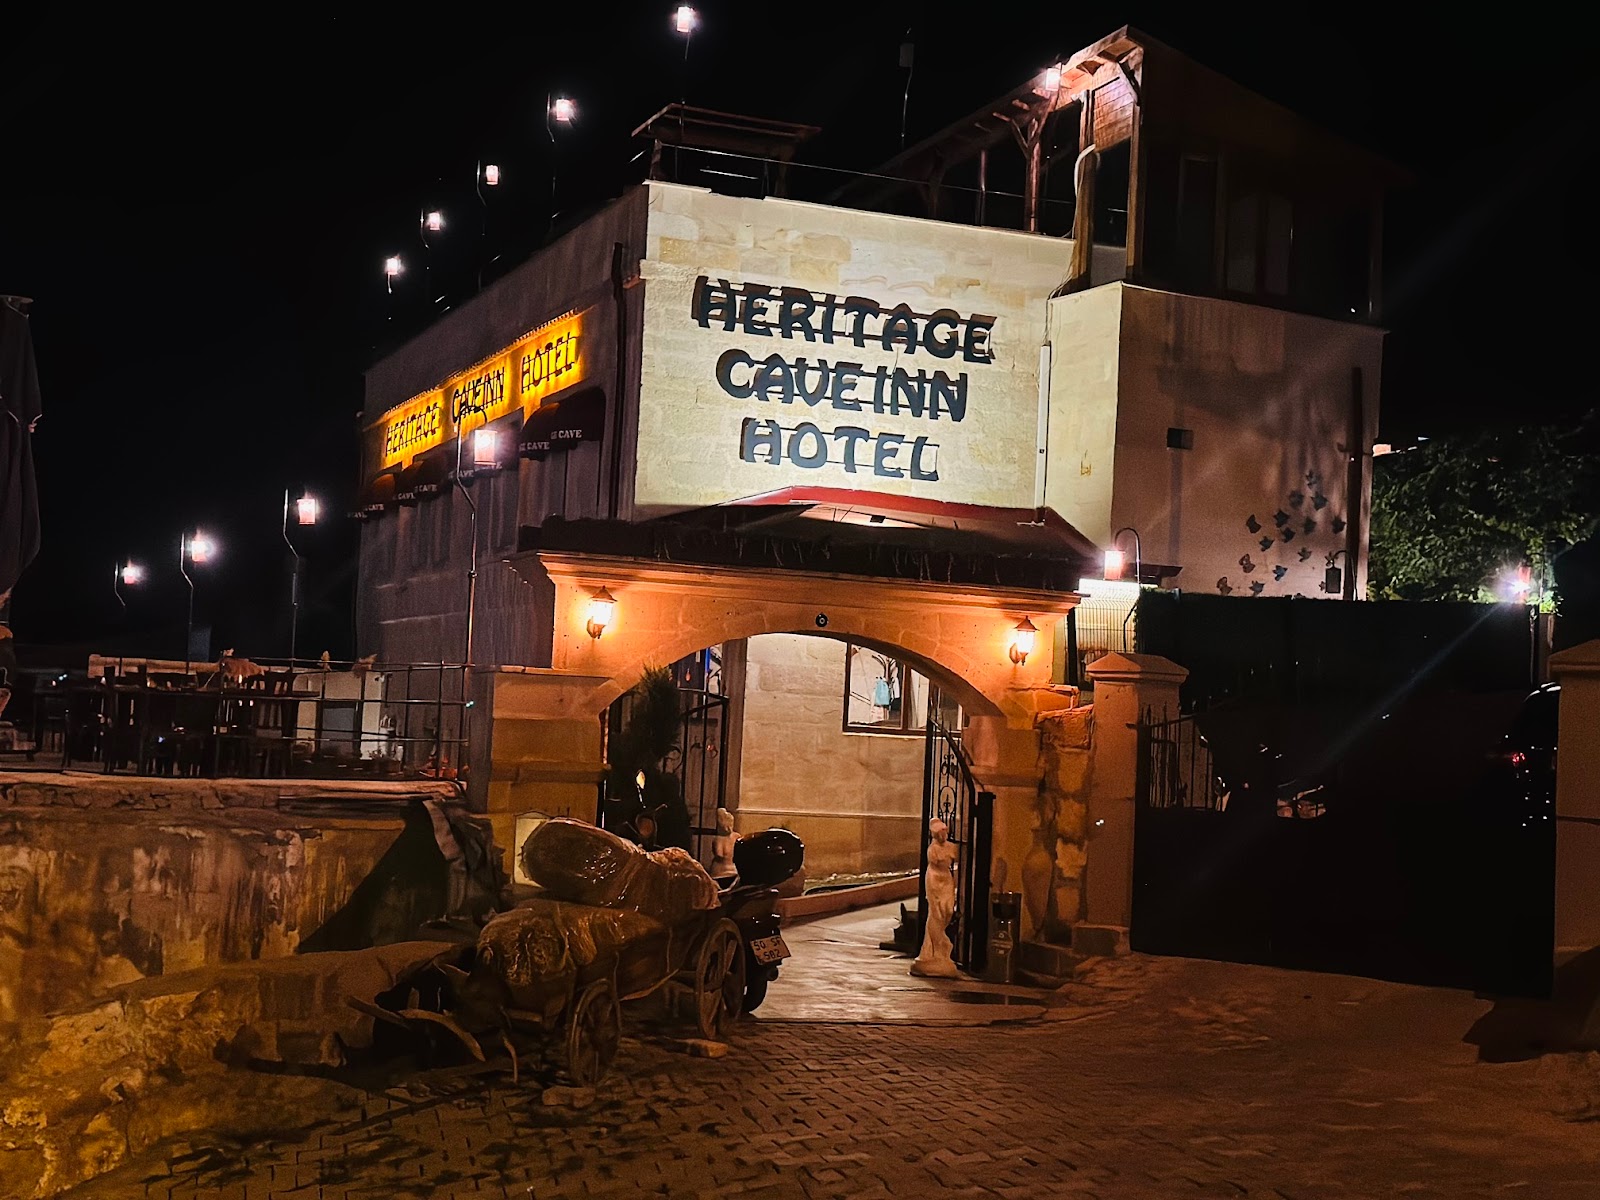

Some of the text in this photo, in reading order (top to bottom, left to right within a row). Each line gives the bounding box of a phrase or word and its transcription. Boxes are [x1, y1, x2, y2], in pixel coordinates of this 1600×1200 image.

[691, 275, 997, 365] HERITAGE
[521, 332, 574, 394] HOTEL
[527, 441, 550, 450] CAVE
[558, 429, 582, 439] CAVE
[740, 416, 939, 482] HOTEL
